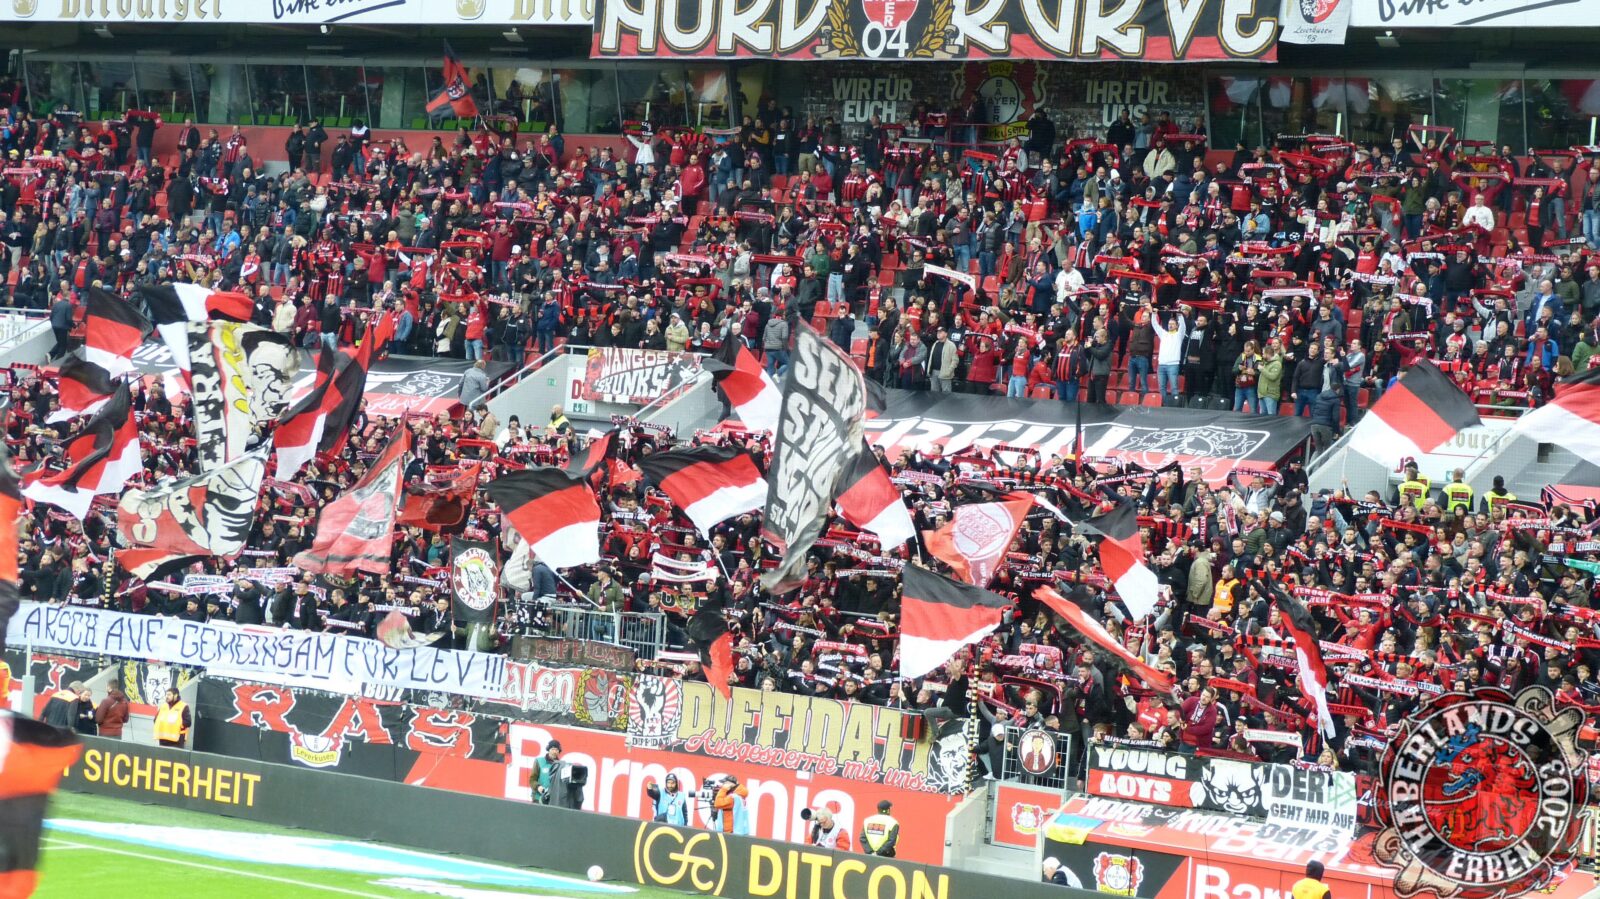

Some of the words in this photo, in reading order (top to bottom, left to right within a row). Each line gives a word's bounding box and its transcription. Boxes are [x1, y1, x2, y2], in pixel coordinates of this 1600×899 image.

[862, 20, 909, 58] 04
[832, 78, 871, 100] WIR
[874, 73, 913, 100] FÜR
[1086, 80, 1122, 104] IHR
[1125, 76, 1168, 105] FÜR
[843, 101, 897, 123] EUCH
[594, 365, 668, 398] SKUNKS
[24, 606, 99, 649] ARSCH
[105, 616, 163, 656] AUF
[181, 624, 337, 677] GEMEINSAM
[343, 640, 399, 681] FÜR
[411, 646, 477, 687] LEV
[1523, 630, 1544, 642] MACHT
[1543, 636, 1554, 645] AM
[296, 747, 335, 761] Leverkusen
[631, 736, 672, 747] DIFFIDATI
[685, 729, 838, 775] Ausgesperrte
[844, 760, 881, 784] mit
[884, 769, 939, 793] uns...
[1096, 746, 1188, 782] YOUNG
[83, 749, 262, 807] SICHERHEIT
[503, 720, 855, 864] Brmnia
[1099, 772, 1172, 801] BOYS
[1271, 765, 1326, 804] DER
[1270, 802, 1303, 822] GEHT
[1304, 807, 1330, 825] MIR
[1331, 812, 1355, 830] AUF
[1255, 823, 1319, 847] DEN
[748, 844, 950, 899] DITCON
